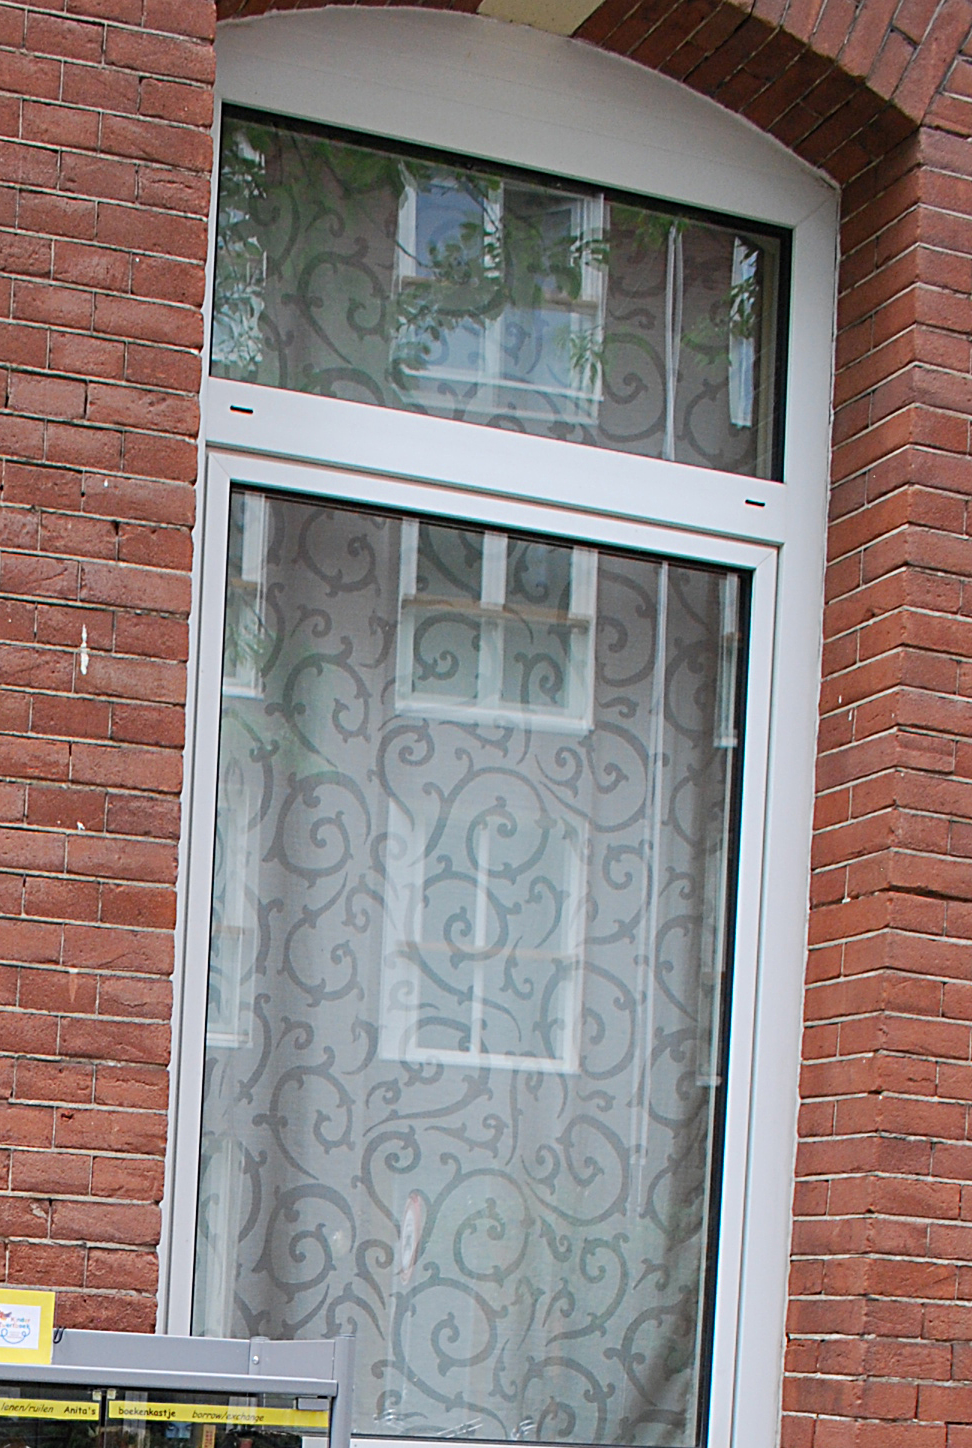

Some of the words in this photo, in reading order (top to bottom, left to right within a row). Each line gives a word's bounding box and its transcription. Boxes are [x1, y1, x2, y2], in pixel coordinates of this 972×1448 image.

[1, 1402, 54, 1413] lenen/ruilen
[63, 1405, 96, 1415] Anita's
[118, 1407, 176, 1418] boekenkastje
[192, 1409, 265, 1423] borrow/exchange
